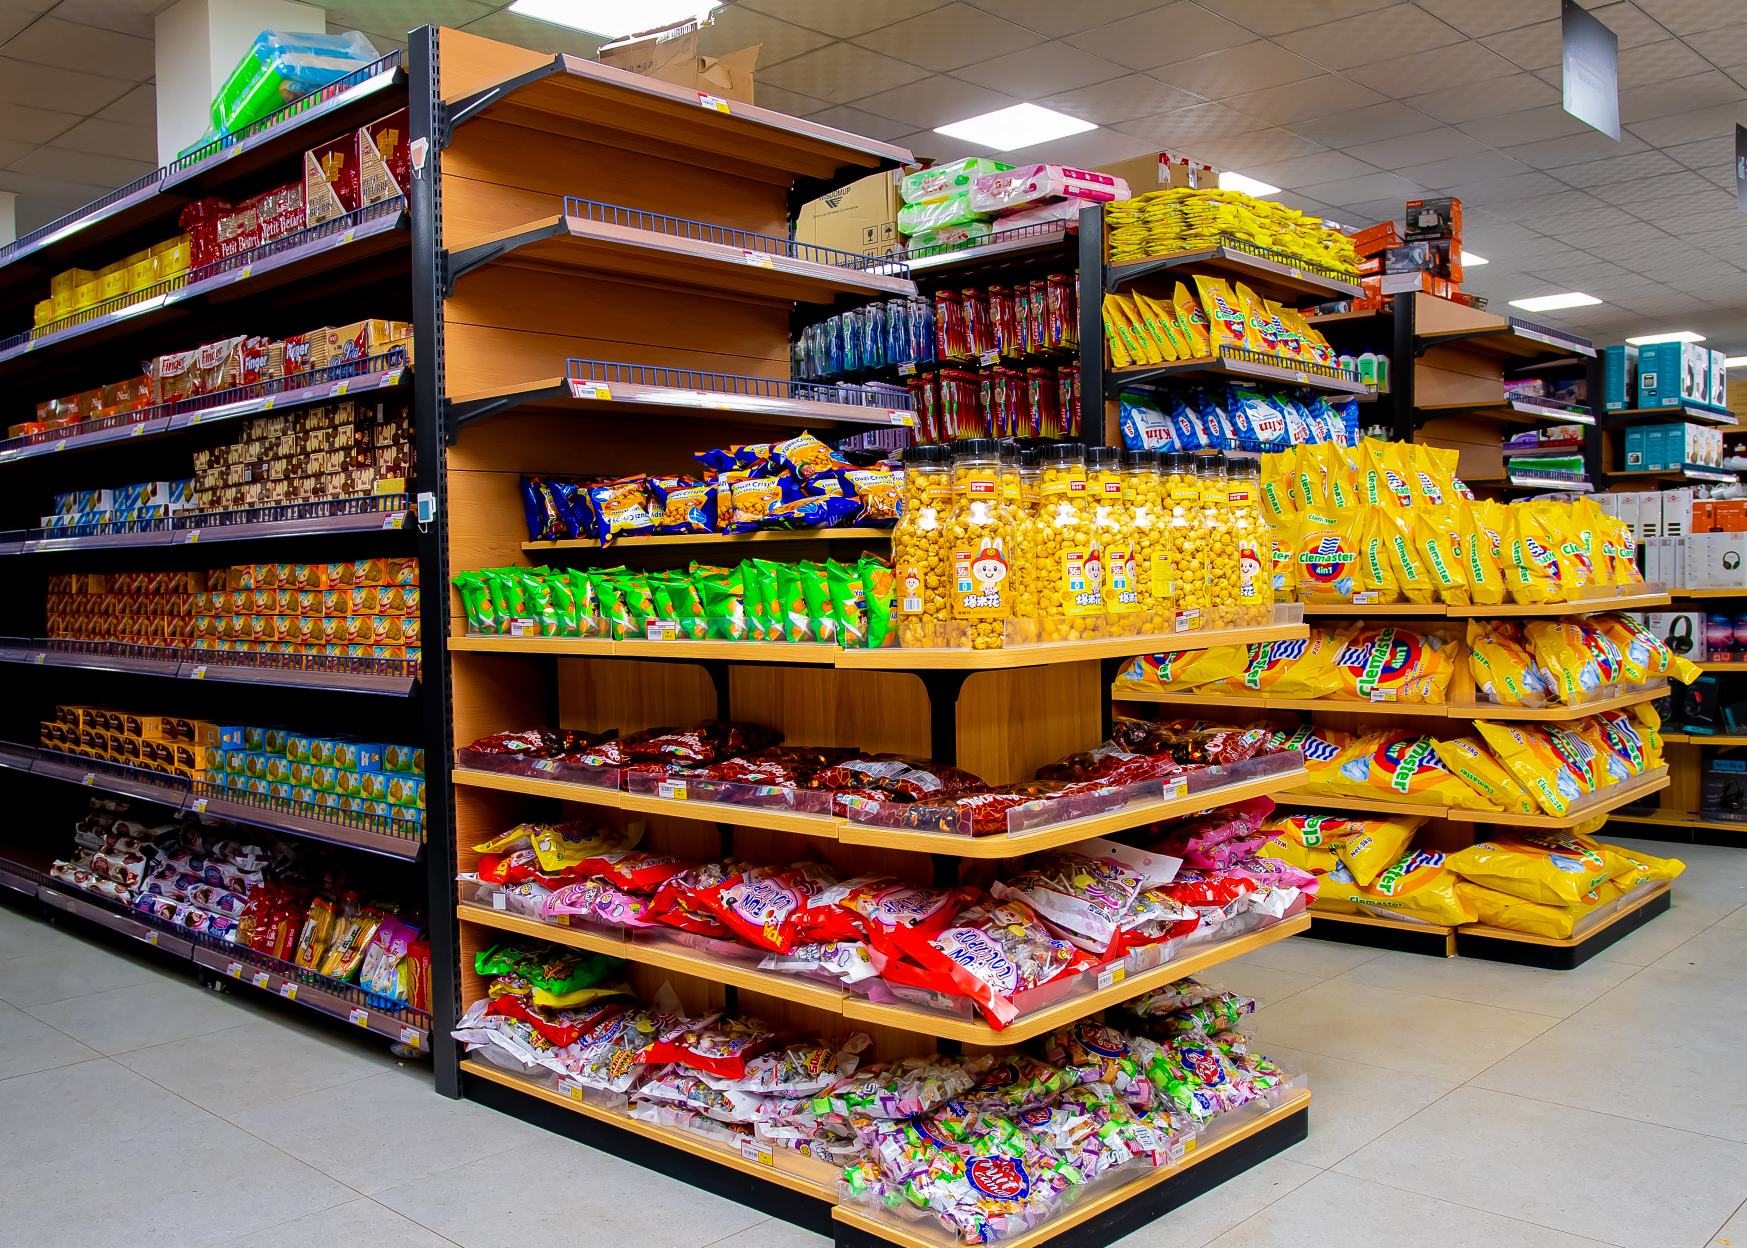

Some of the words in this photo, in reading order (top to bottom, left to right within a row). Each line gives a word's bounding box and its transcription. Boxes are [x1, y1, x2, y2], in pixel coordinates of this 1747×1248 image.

[161, 356, 186, 373] Finger
[1209, 417, 1219, 435] Klin
[1236, 412, 1247, 429] Klin
[1301, 473, 1313, 505] Clemas
[1368, 470, 1378, 505] Clemast
[1299, 551, 1355, 564] Clemaster
[1315, 565, 1333, 575] 4in1
[1369, 538, 1383, 585] Clemaster
[1394, 535, 1417, 581] Clemaster
[1426, 540, 1451, 585] Clemaster
[1470, 533, 1485, 583] Clemaster
[963, 593, 1002, 608] 爆米花
[1247, 642, 1273, 689] aster
[1358, 628, 1395, 697] Clemaste
[1392, 646, 1408, 669] 4in1
[1460, 768, 1496, 795] Clemaster
[742, 893, 768, 918] FUN
